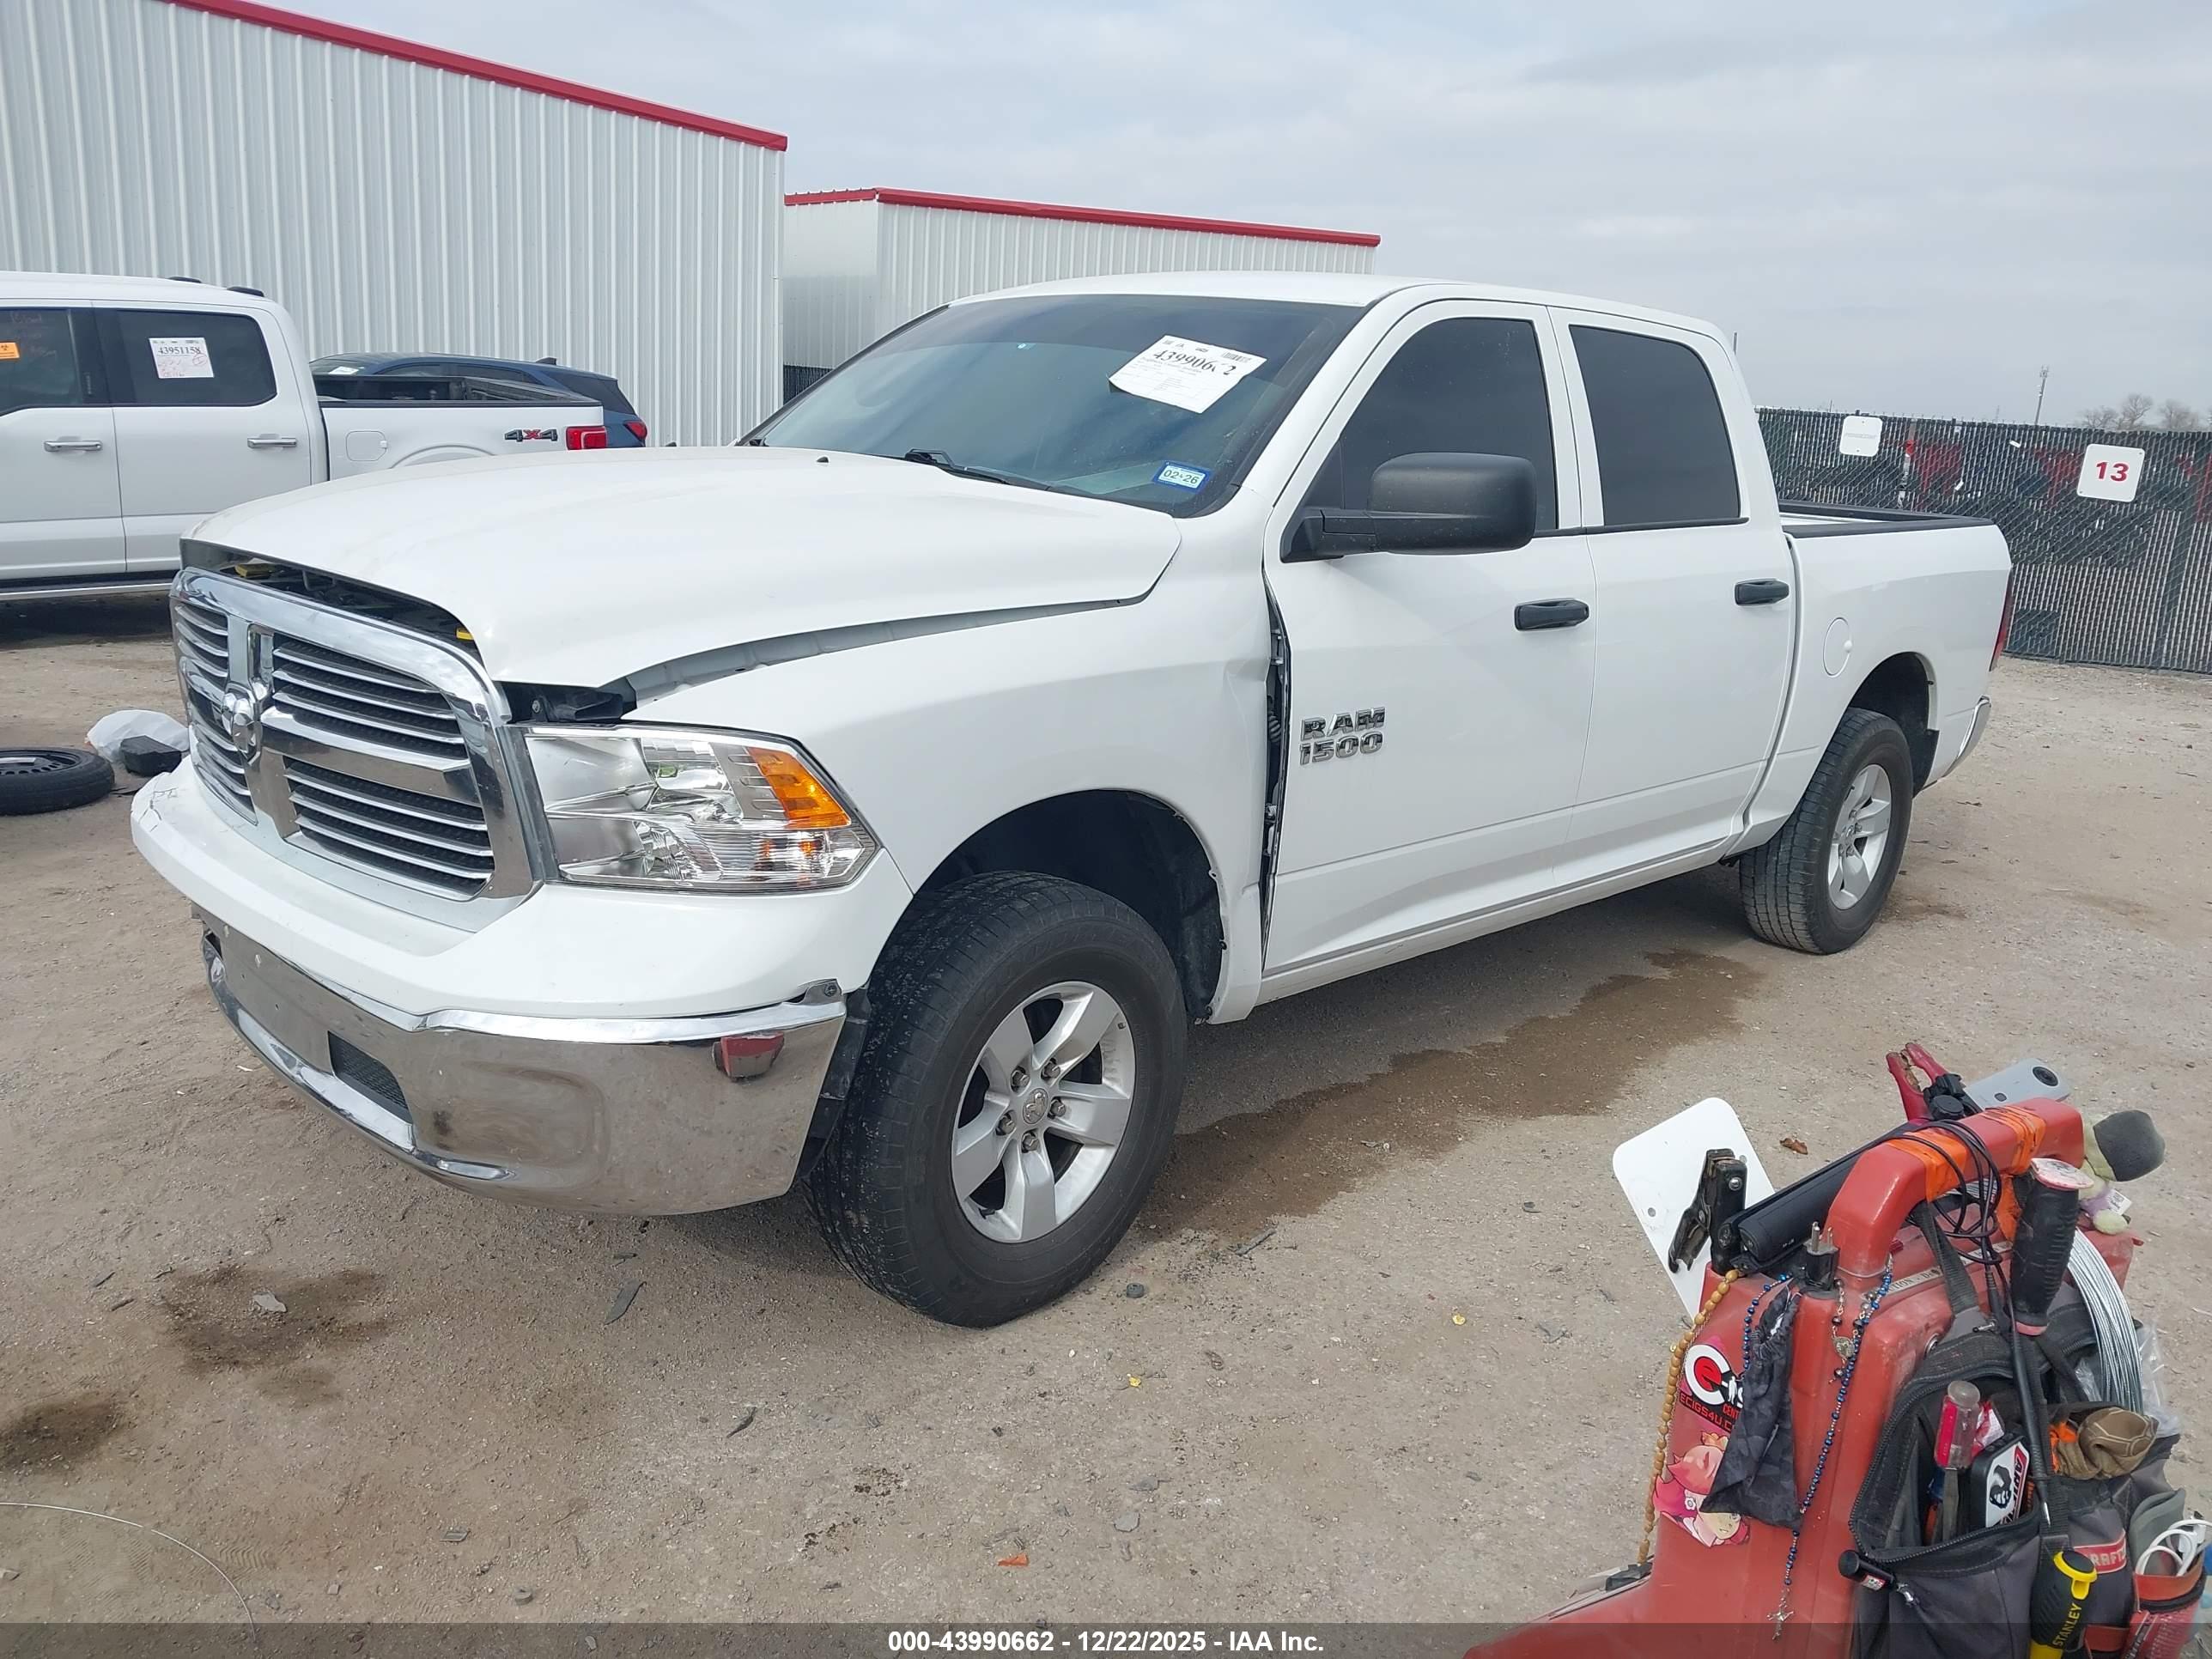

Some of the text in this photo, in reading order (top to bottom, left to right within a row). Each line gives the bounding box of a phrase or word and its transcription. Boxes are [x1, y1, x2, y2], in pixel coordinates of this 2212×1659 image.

[157, 346, 201, 355] 43951158
[2096, 461, 2130, 482] 13
[1300, 707, 1385, 741] RAM
[1300, 732, 1383, 765] 1500
[2051, 1601, 2082, 1646] STANLEY
